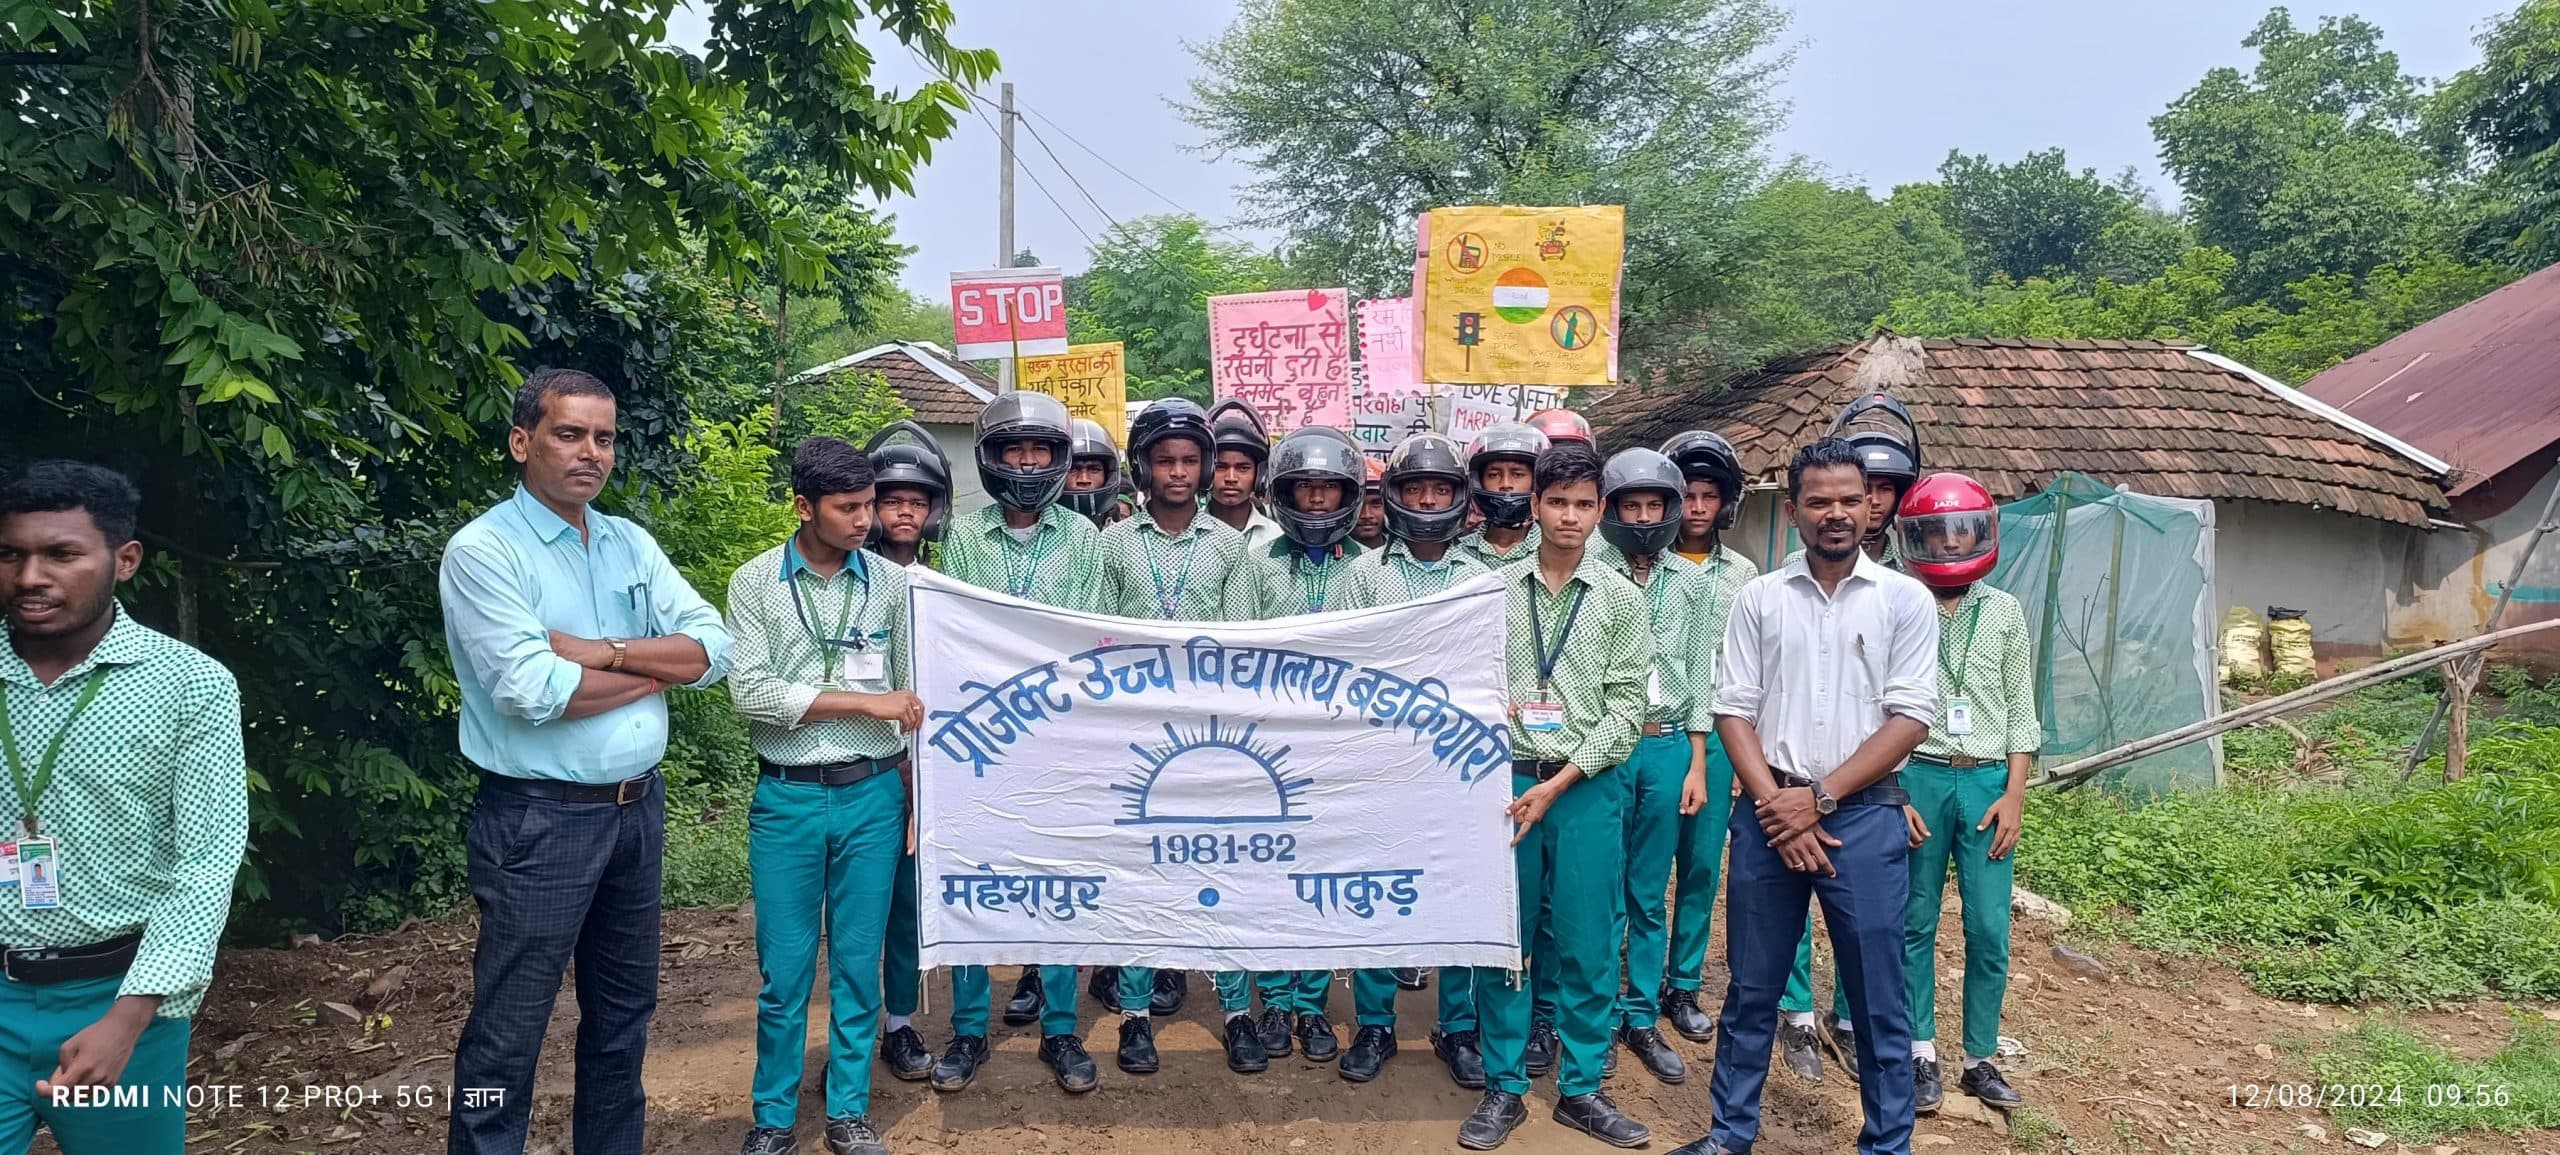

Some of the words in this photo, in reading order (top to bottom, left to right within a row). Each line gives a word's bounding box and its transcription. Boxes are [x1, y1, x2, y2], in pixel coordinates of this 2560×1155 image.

[959, 284, 1063, 326] STOP
[1318, 309, 1347, 355] से
[1325, 347, 1346, 380] है
[1057, 376, 1106, 403] पुकार
[1462, 384, 1504, 405] LOVE
[928, 661, 1073, 777] प्रोजेक्ट
[1149, 833, 1297, 865] 1981-82
[940, 863, 1107, 921] महेशपुर
[1288, 868, 1424, 918] पाकुड़
